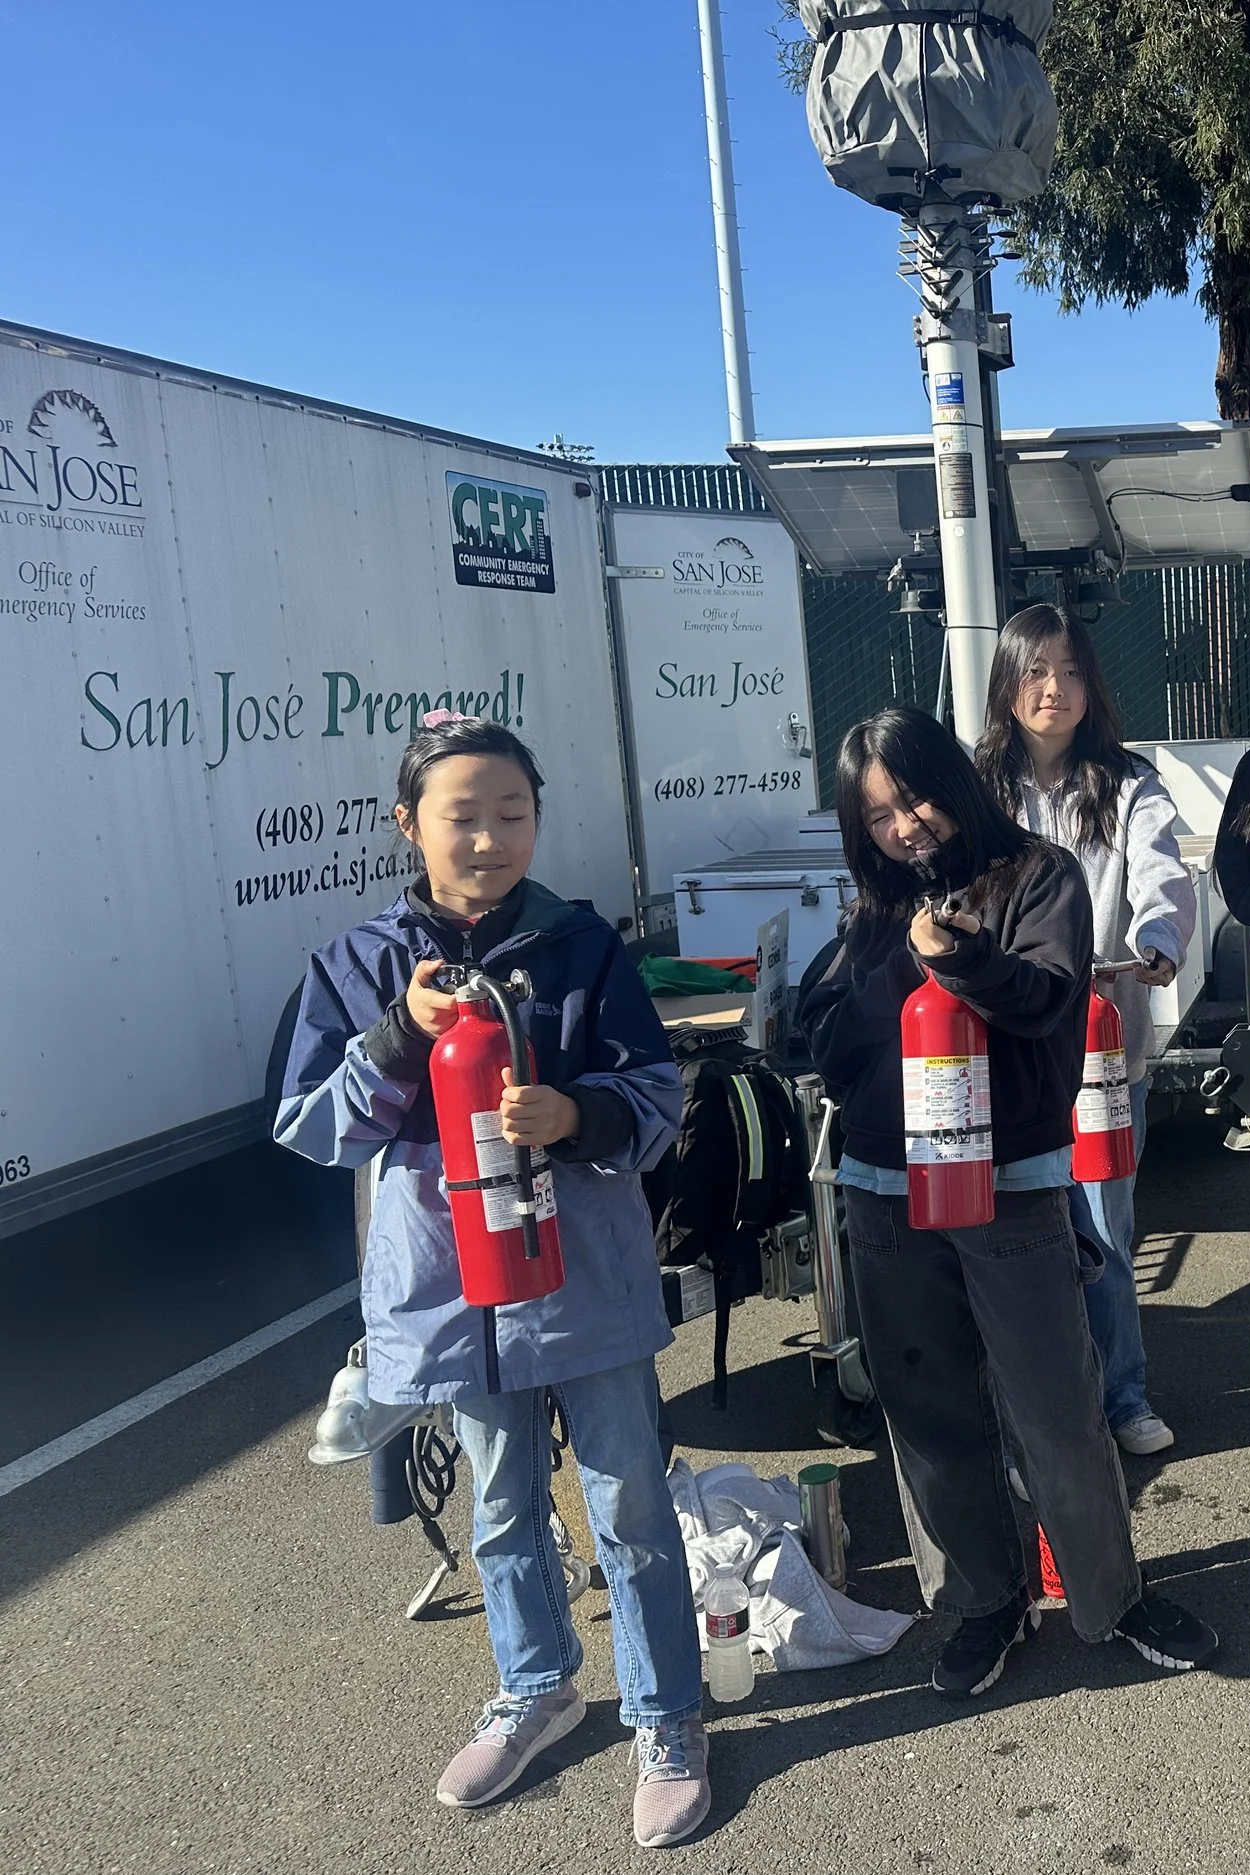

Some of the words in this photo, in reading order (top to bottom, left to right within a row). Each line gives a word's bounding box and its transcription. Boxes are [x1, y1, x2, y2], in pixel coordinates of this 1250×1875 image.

[46, 444, 142, 511] JOSE
[16, 511, 36, 527] OF
[40, 514, 95, 533] SILICON
[98, 520, 145, 538] VALLEY
[452, 482, 545, 554] CERT
[459, 553, 506, 571] COMMUNITY
[508, 559, 550, 576] EMERGENCY
[678, 551, 694, 559] CITY
[18, 561, 72, 592] Office
[80, 565, 98, 595] of
[478, 570, 516, 586] RESPONSE
[516, 575, 537, 588] TEAM
[672, 559, 715, 582] SAN
[717, 560, 764, 588] JOSE
[673, 587, 702, 595] CAPITAL
[703, 588, 712, 596] OF
[713, 588, 740, 596] SILICON
[741, 589, 764, 597] VALLEY
[84, 596, 146, 621] Services
[703, 608, 728, 622] Office
[730, 608, 740, 621] of
[683, 620, 729, 634] Emergency
[731, 620, 763, 632] Services
[655, 662, 718, 698] San
[720, 662, 784, 708] José
[80, 671, 195, 752] San
[205, 671, 305, 770] José
[654, 775, 705, 802] (408)
[713, 770, 801, 797] 277-4598
[255, 801, 324, 852] (408)
[336, 797, 397, 837] 277-
[926, 1057, 970, 1065] INSTRUCTIONS
